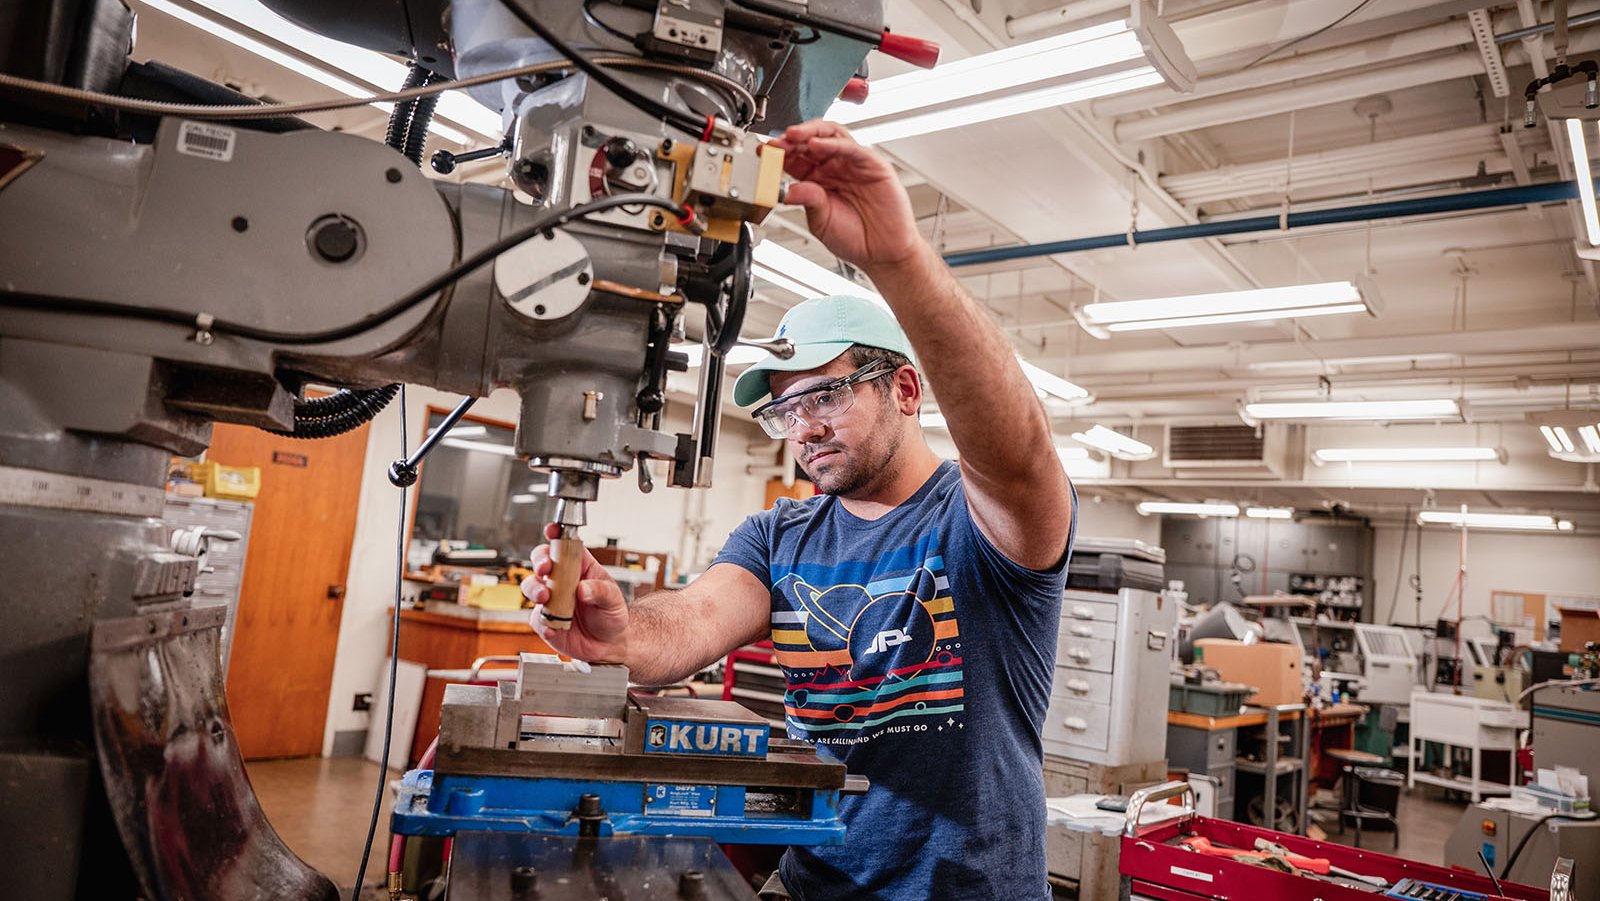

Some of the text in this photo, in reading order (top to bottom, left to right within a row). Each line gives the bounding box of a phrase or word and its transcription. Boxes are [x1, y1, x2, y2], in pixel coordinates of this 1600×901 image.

[185, 124, 232, 137] CALTECH
[669, 724, 764, 753] KURT
[817, 737, 830, 745] ARE
[831, 737, 854, 745] CALLIN
[872, 729, 885, 739] WE
[886, 725, 911, 734] MUST
[913, 724, 928, 732] GO
